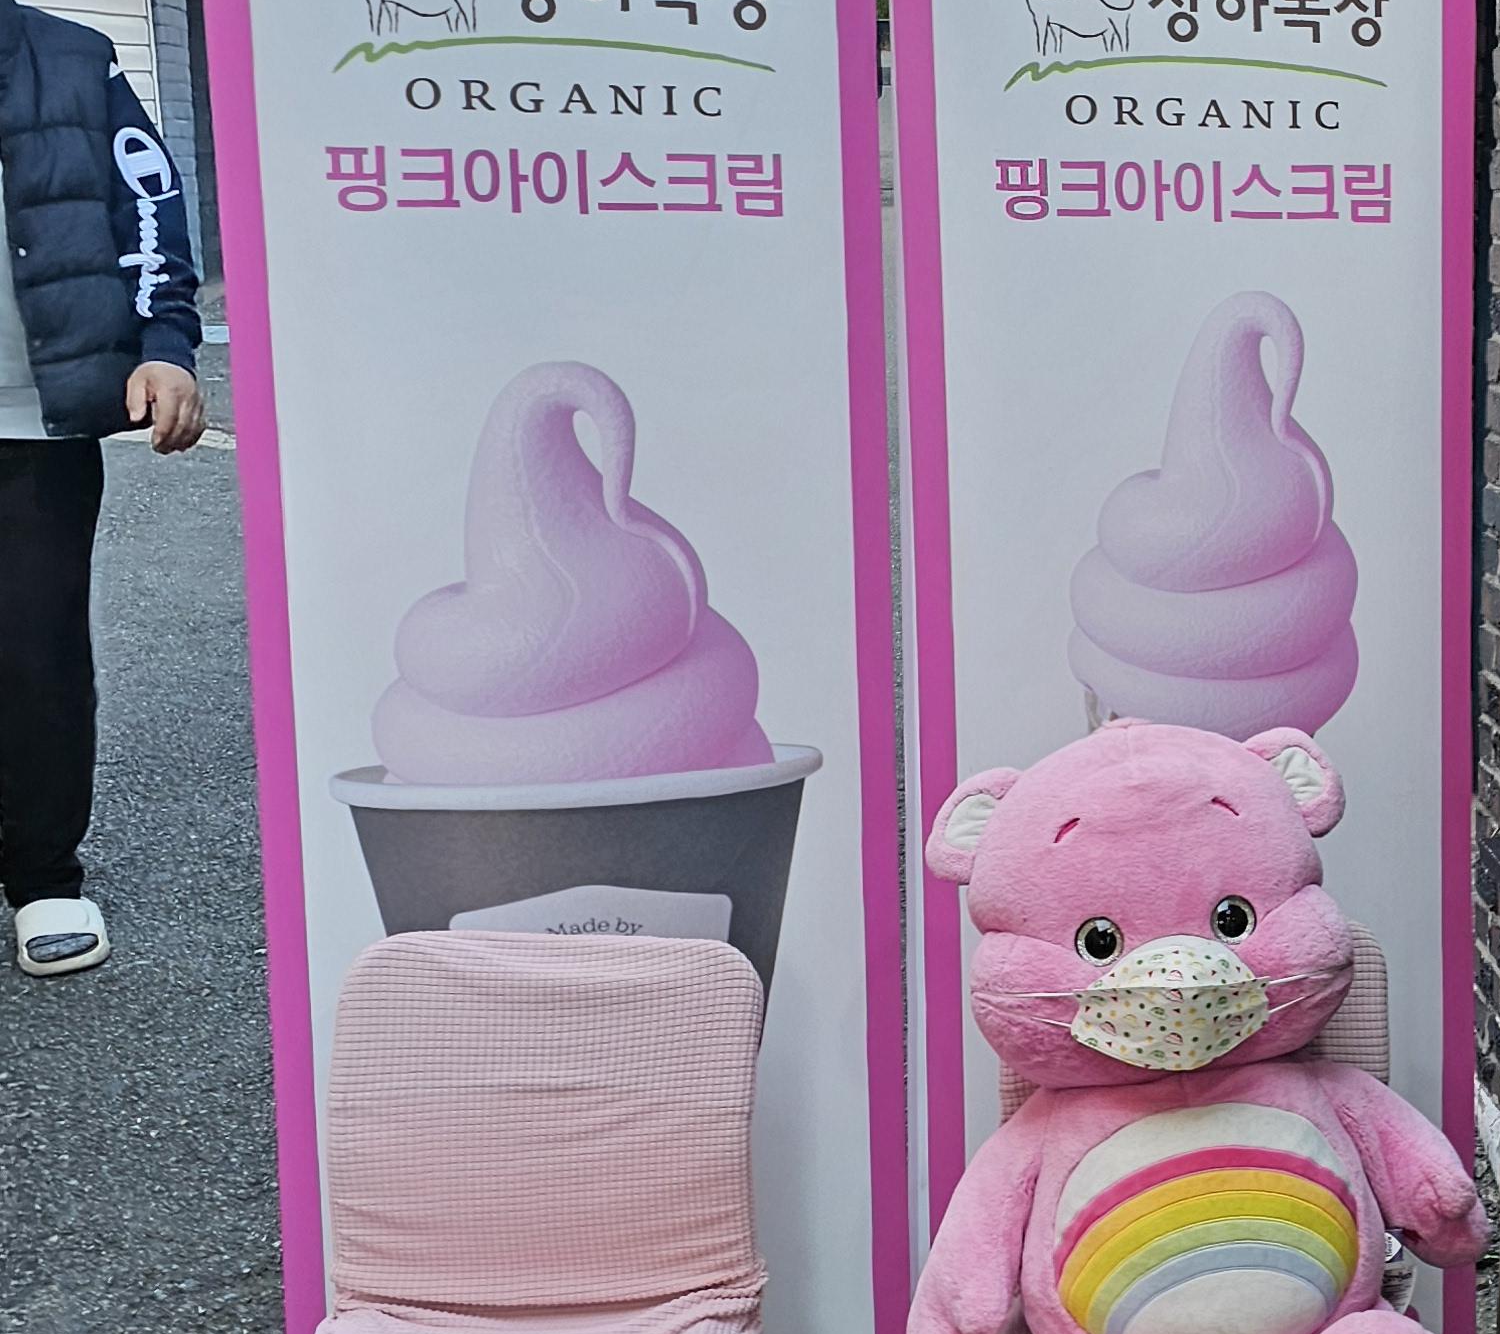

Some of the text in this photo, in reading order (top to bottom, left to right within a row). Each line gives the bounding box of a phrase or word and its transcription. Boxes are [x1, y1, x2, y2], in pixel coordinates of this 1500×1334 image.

[405, 77, 724, 118] ORGANIC
[1065, 94, 1340, 130] ORGANIC
[324, 145, 784, 218] 핑크아이스크림
[994, 158, 1393, 223] 핑크아이스크림
[615, 917, 643, 936] by
